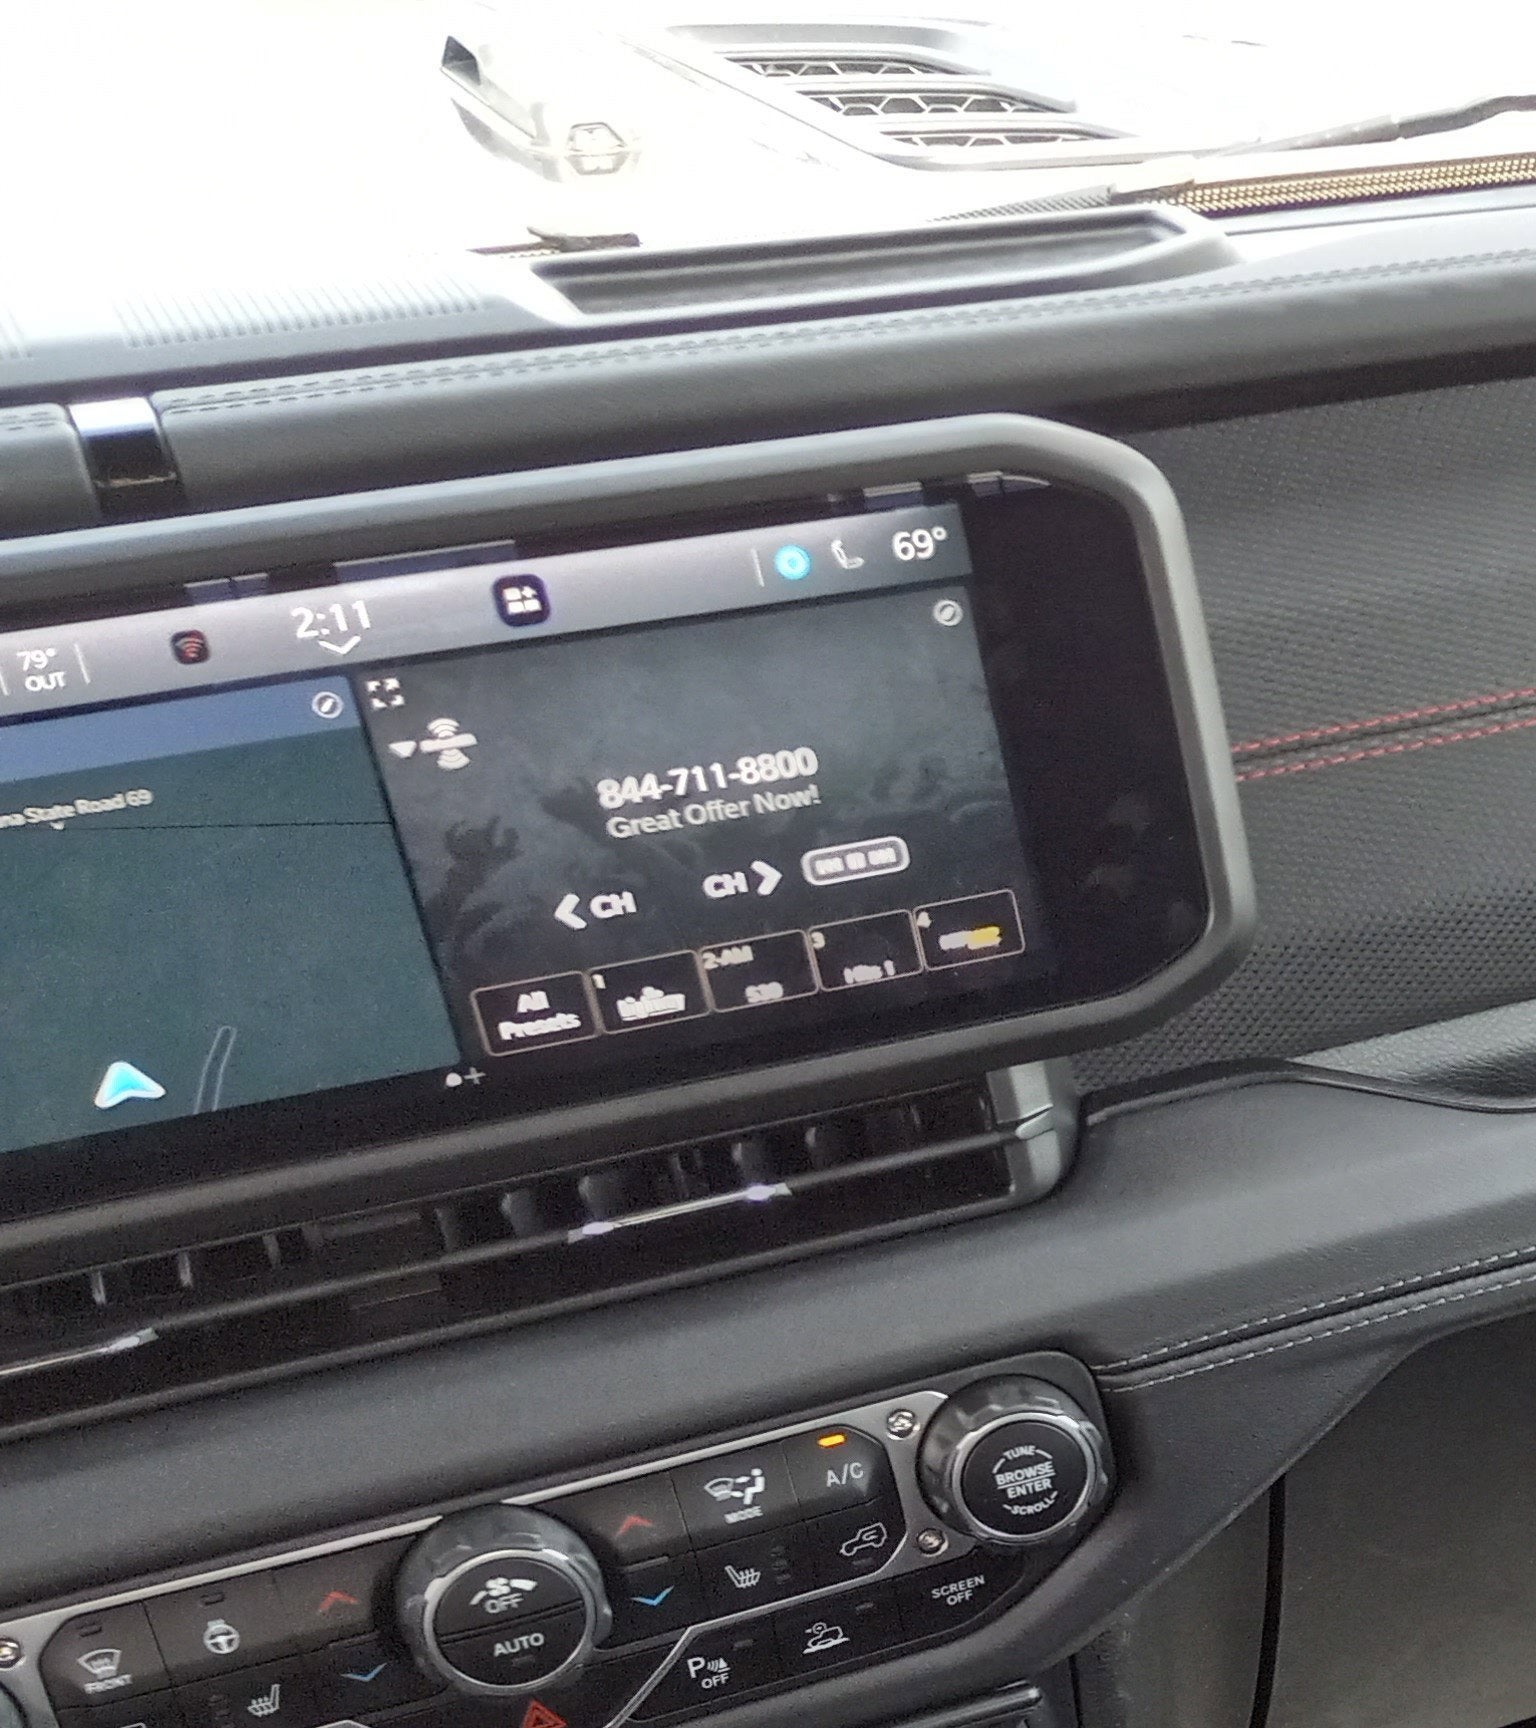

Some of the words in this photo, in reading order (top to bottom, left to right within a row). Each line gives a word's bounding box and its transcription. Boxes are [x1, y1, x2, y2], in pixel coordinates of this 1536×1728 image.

[290, 600, 371, 639] 2:11
[25, 671, 67, 692] OUT
[597, 746, 819, 809] 844-711-8800
[23, 804, 77, 823] State
[74, 793, 126, 814] Road
[606, 808, 684, 838] Great
[684, 799, 750, 825] Offer
[753, 783, 822, 814] Now!
[1003, 1445, 1036, 1460] TUNE
[825, 1461, 865, 1488] A/C
[995, 1461, 1055, 1486] BROWSE
[1007, 1478, 1053, 1499] ENTER
[1011, 1497, 1055, 1515] SCROLL
[931, 1574, 986, 1599] SCREEN
[946, 1589, 974, 1606] OFF
[493, 1633, 545, 1658] AUTO
[701, 1672, 730, 1690] OFF
